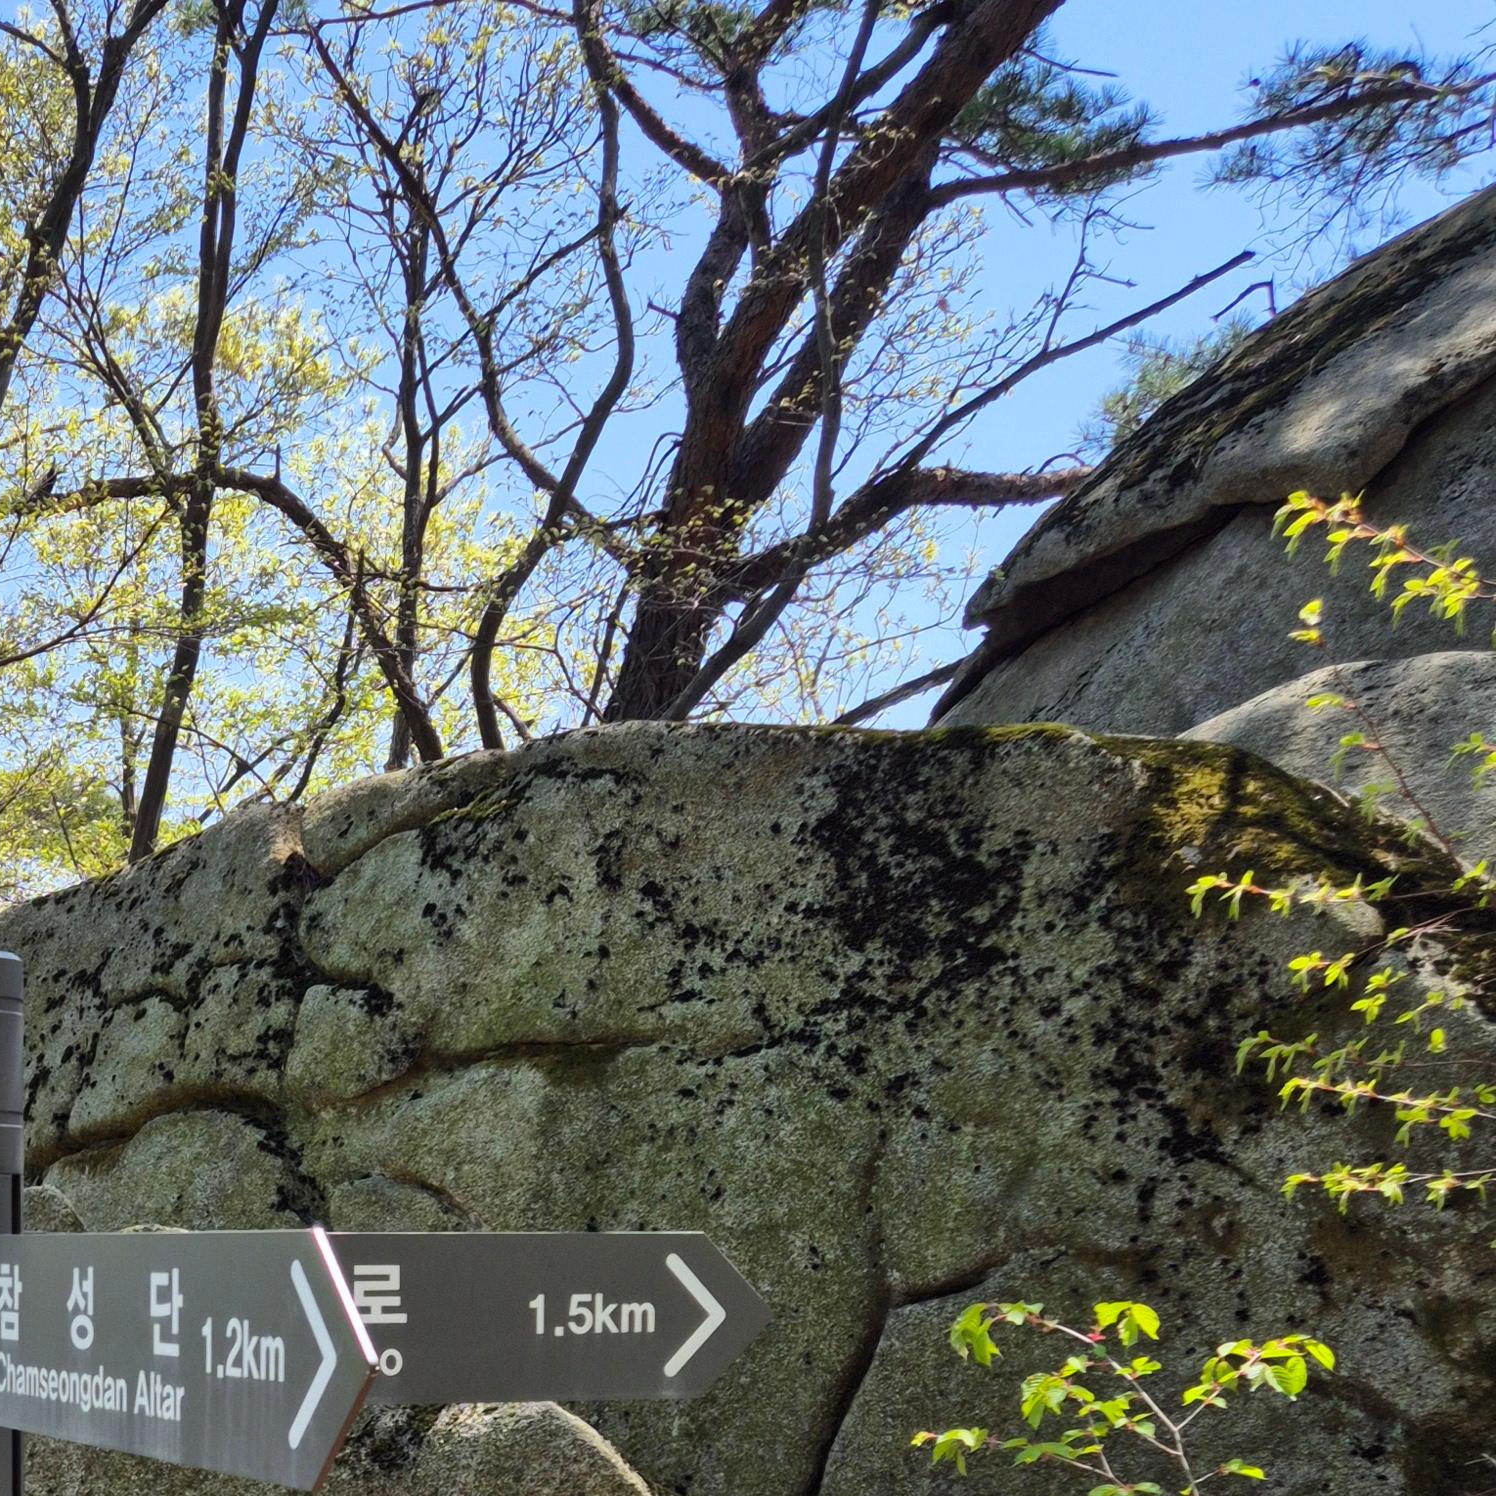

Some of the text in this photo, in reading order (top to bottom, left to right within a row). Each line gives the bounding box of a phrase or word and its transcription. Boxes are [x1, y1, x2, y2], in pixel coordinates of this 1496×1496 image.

[528, 1292, 656, 1337] 1.5km
[201, 1316, 285, 1382] 1.2km
[133, 1369, 185, 1422] Altar
